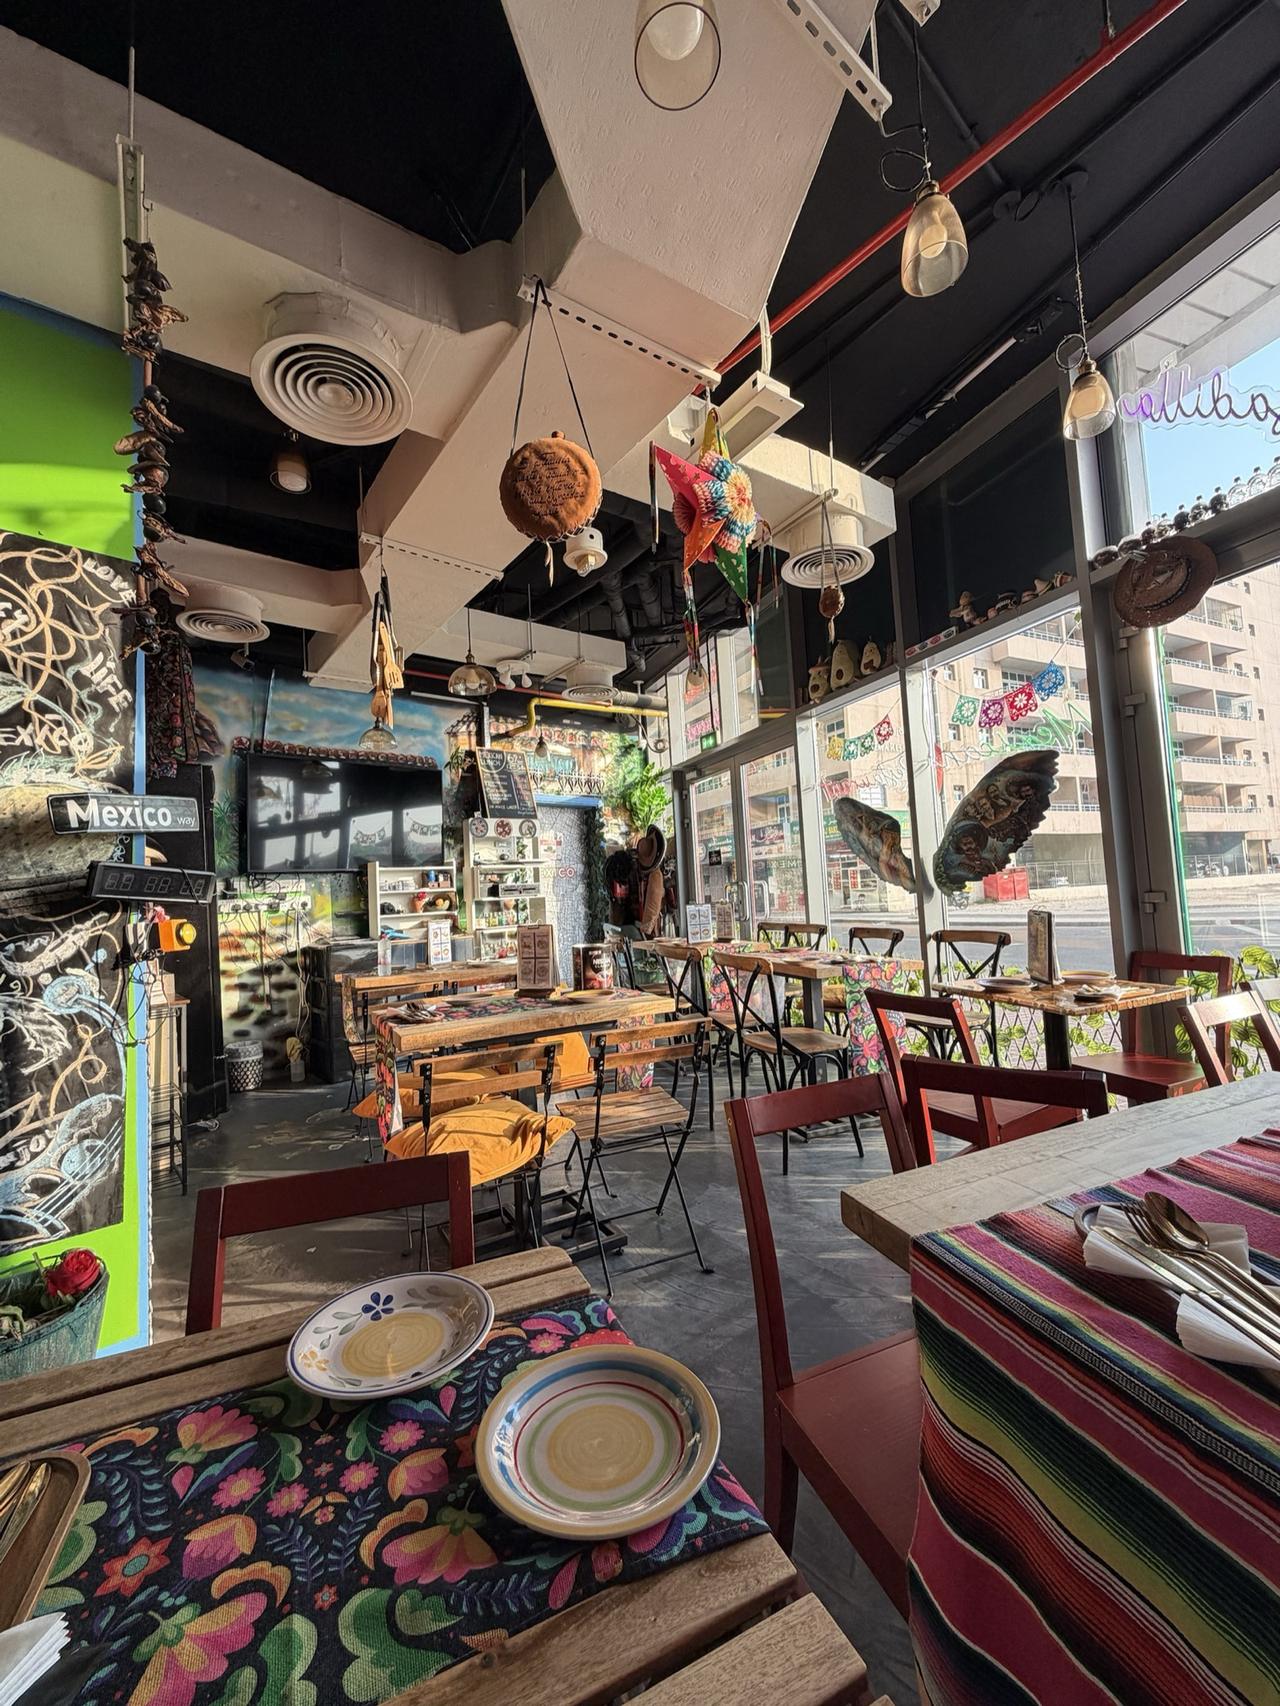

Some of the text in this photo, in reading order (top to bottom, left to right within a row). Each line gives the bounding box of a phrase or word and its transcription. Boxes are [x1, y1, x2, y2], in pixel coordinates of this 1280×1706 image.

[83, 557, 137, 607] LOVE
[80, 651, 133, 712] LIFE
[66, 798, 196, 828] Mexico way
